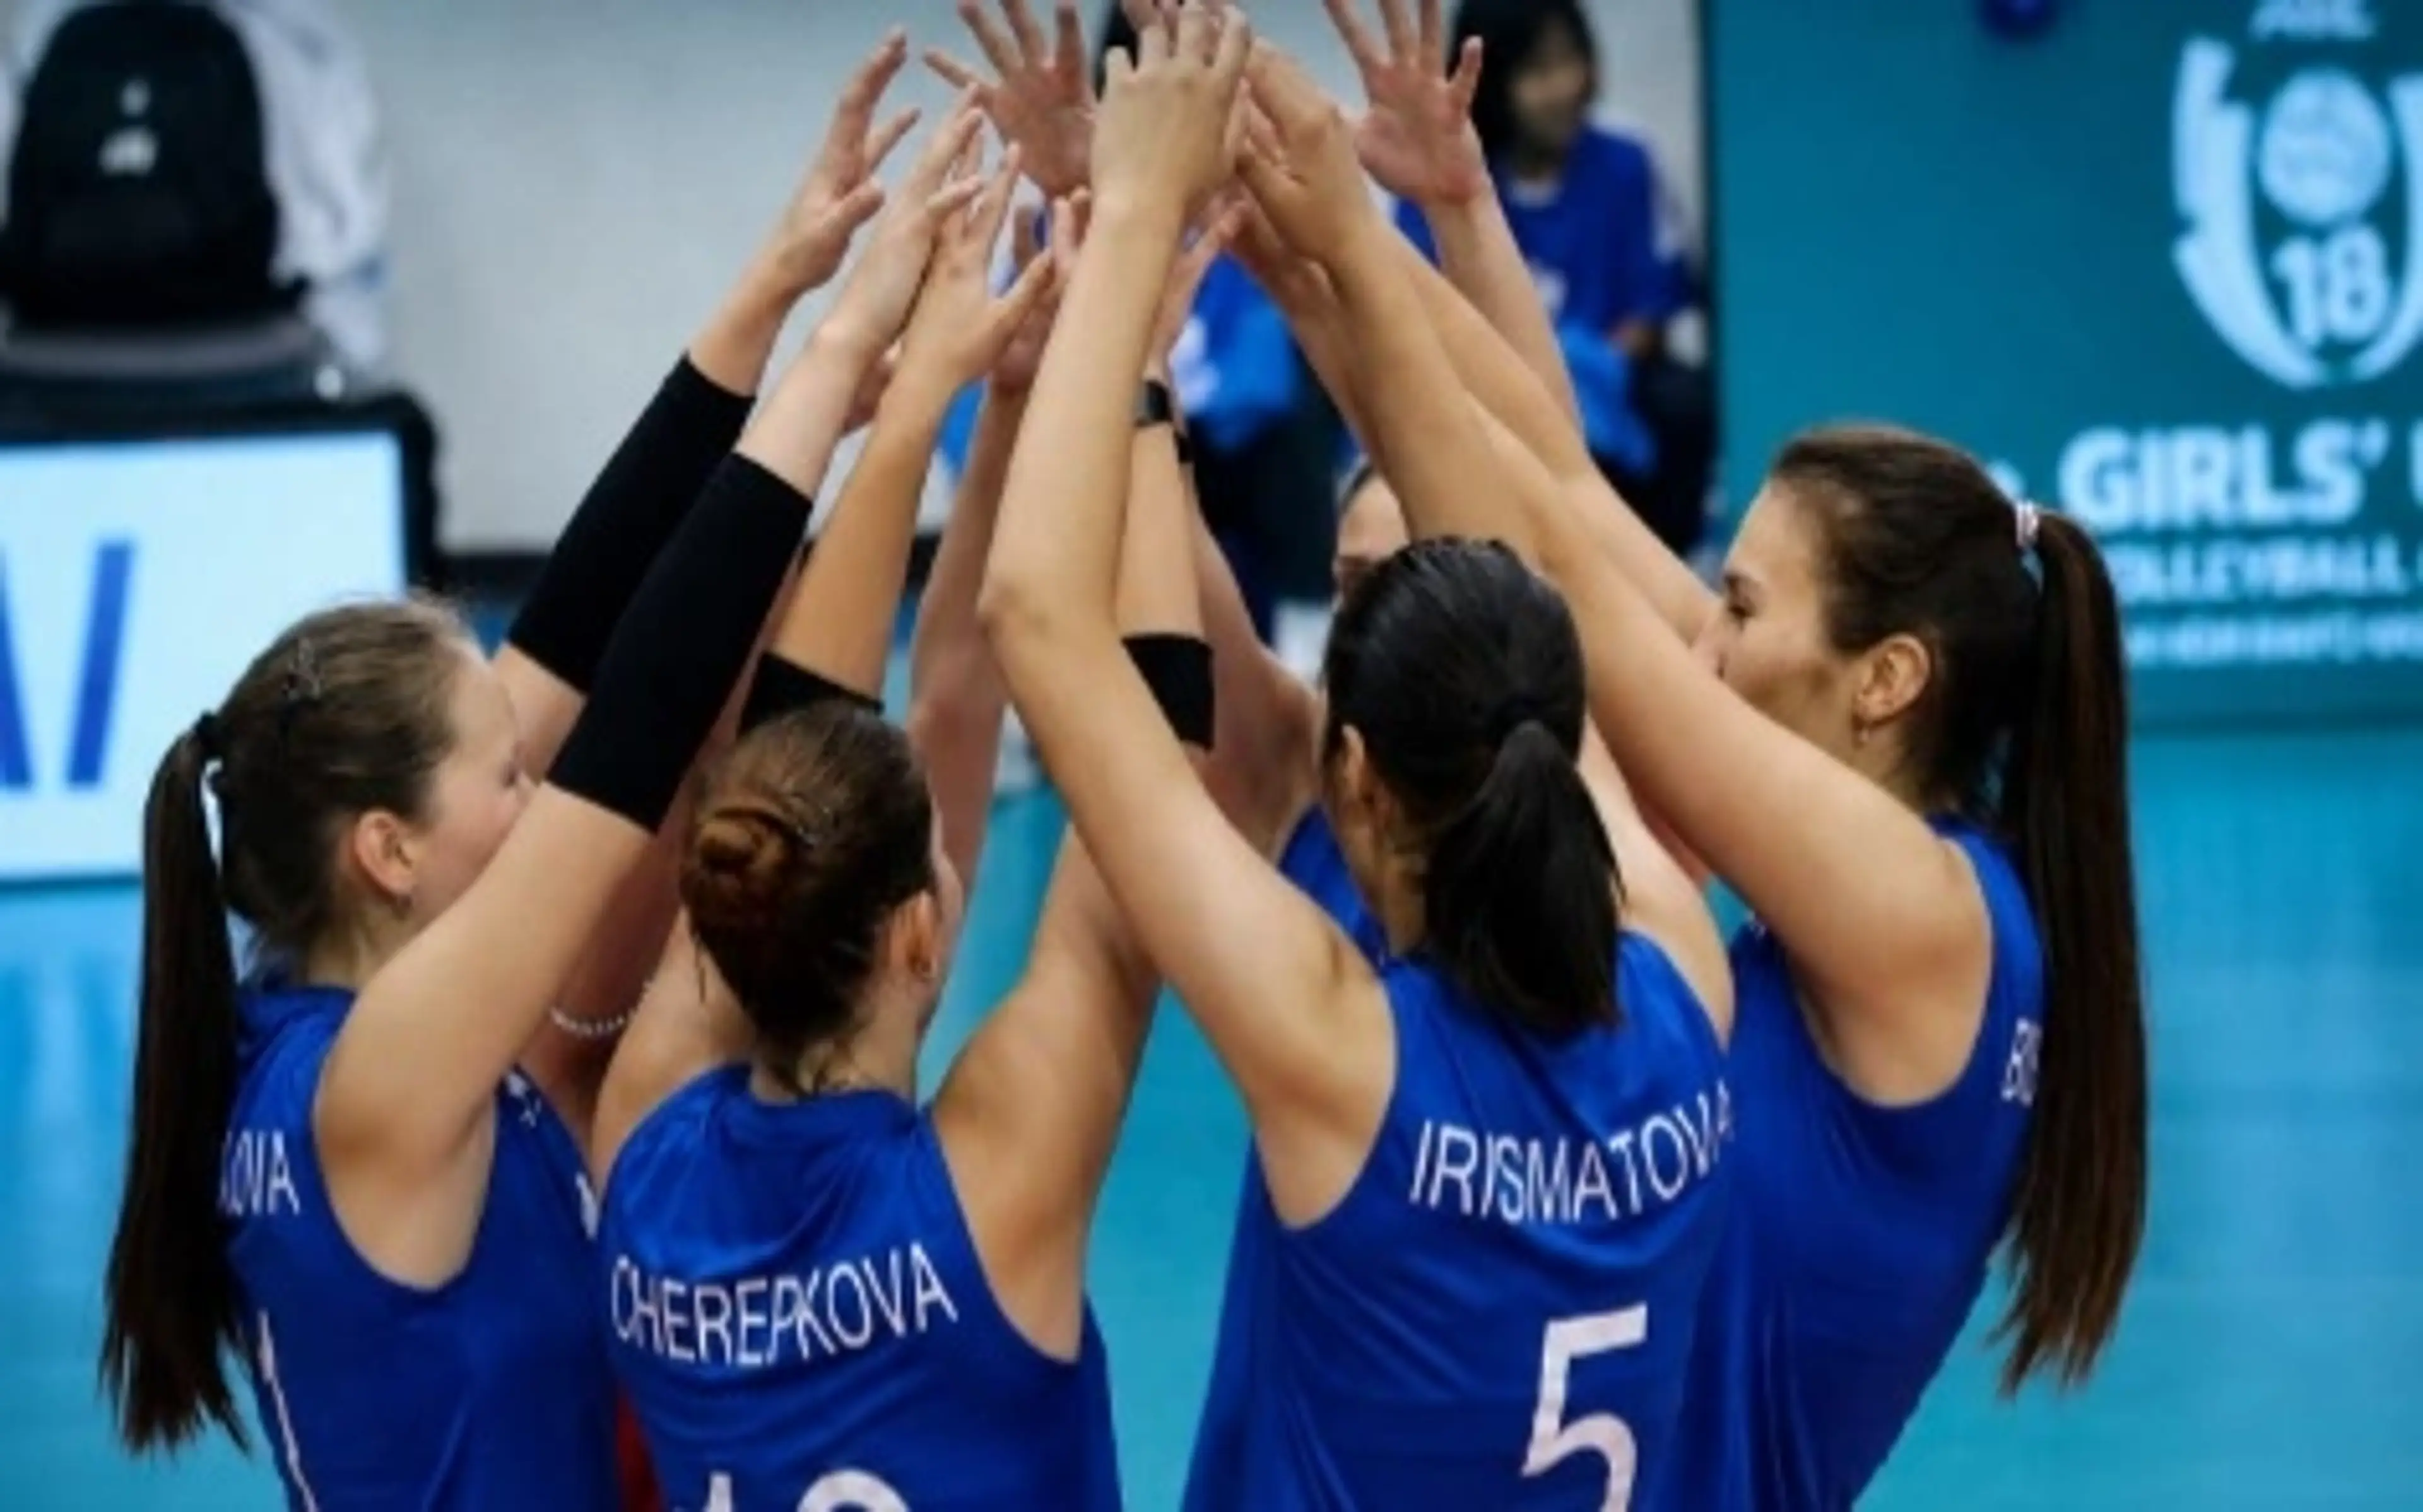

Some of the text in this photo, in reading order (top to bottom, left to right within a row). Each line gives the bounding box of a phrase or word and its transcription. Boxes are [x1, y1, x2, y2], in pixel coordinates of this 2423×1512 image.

[2273, 224, 2389, 348] 18
[611, 1240, 958, 1366] CHEREPKOVA
[1521, 1303, 1648, 1512] 5
